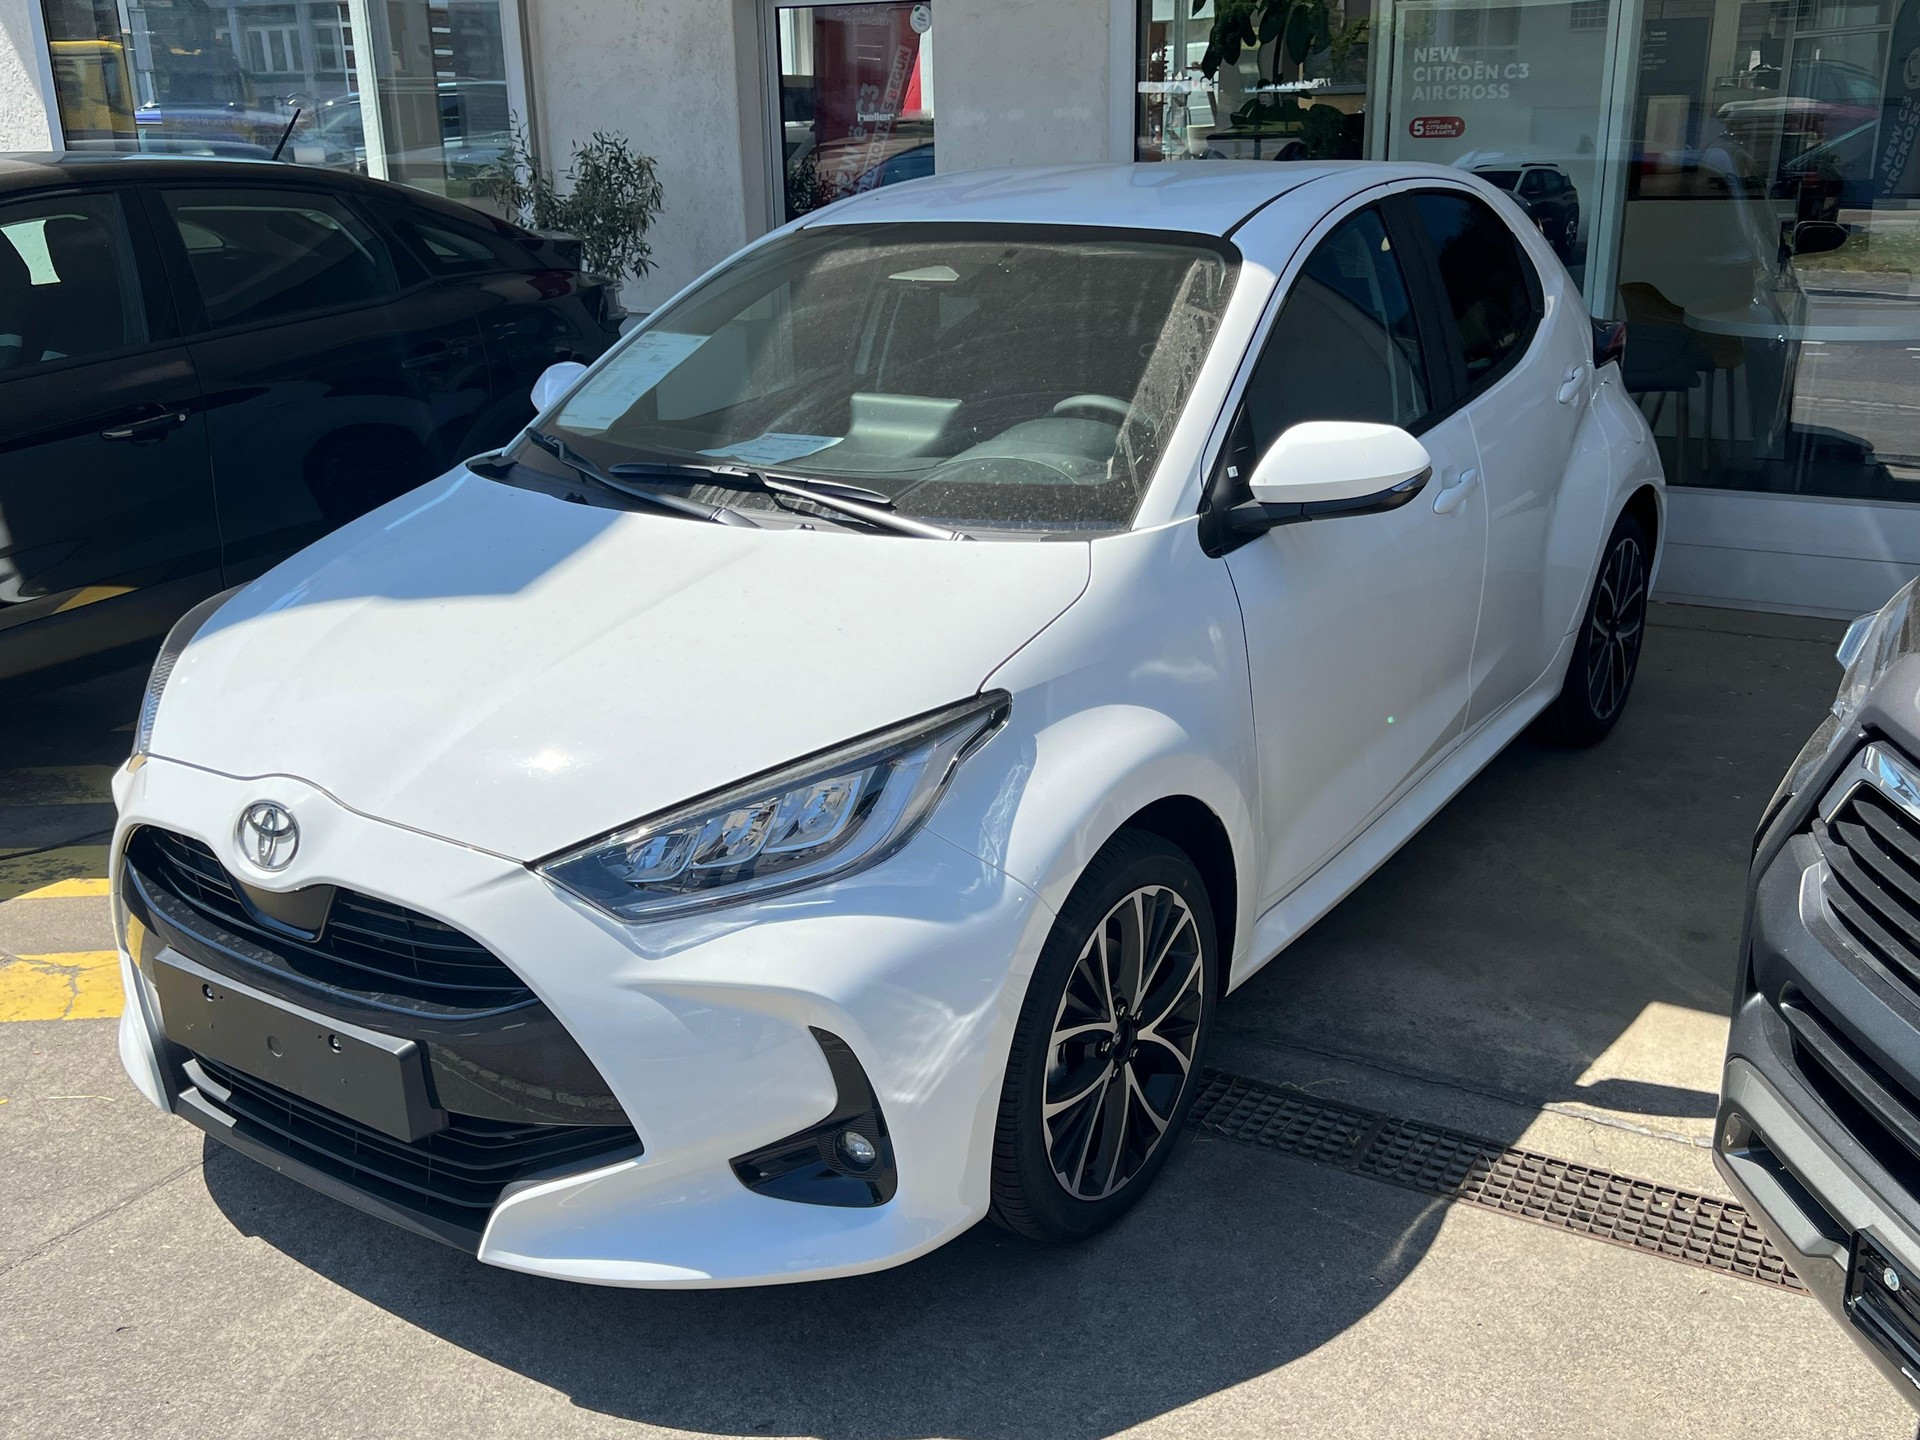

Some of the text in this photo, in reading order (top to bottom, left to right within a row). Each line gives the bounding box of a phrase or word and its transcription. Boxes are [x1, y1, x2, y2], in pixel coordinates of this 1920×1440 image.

[1414, 46, 1460, 62] NEW
[1413, 60, 1530, 82] CITROËN C3
[1412, 83, 1511, 101] AIRCROSS
[857, 112, 895, 122] heller
[1413, 120, 1425, 136] 5
[1880, 124, 1903, 173] NEW
